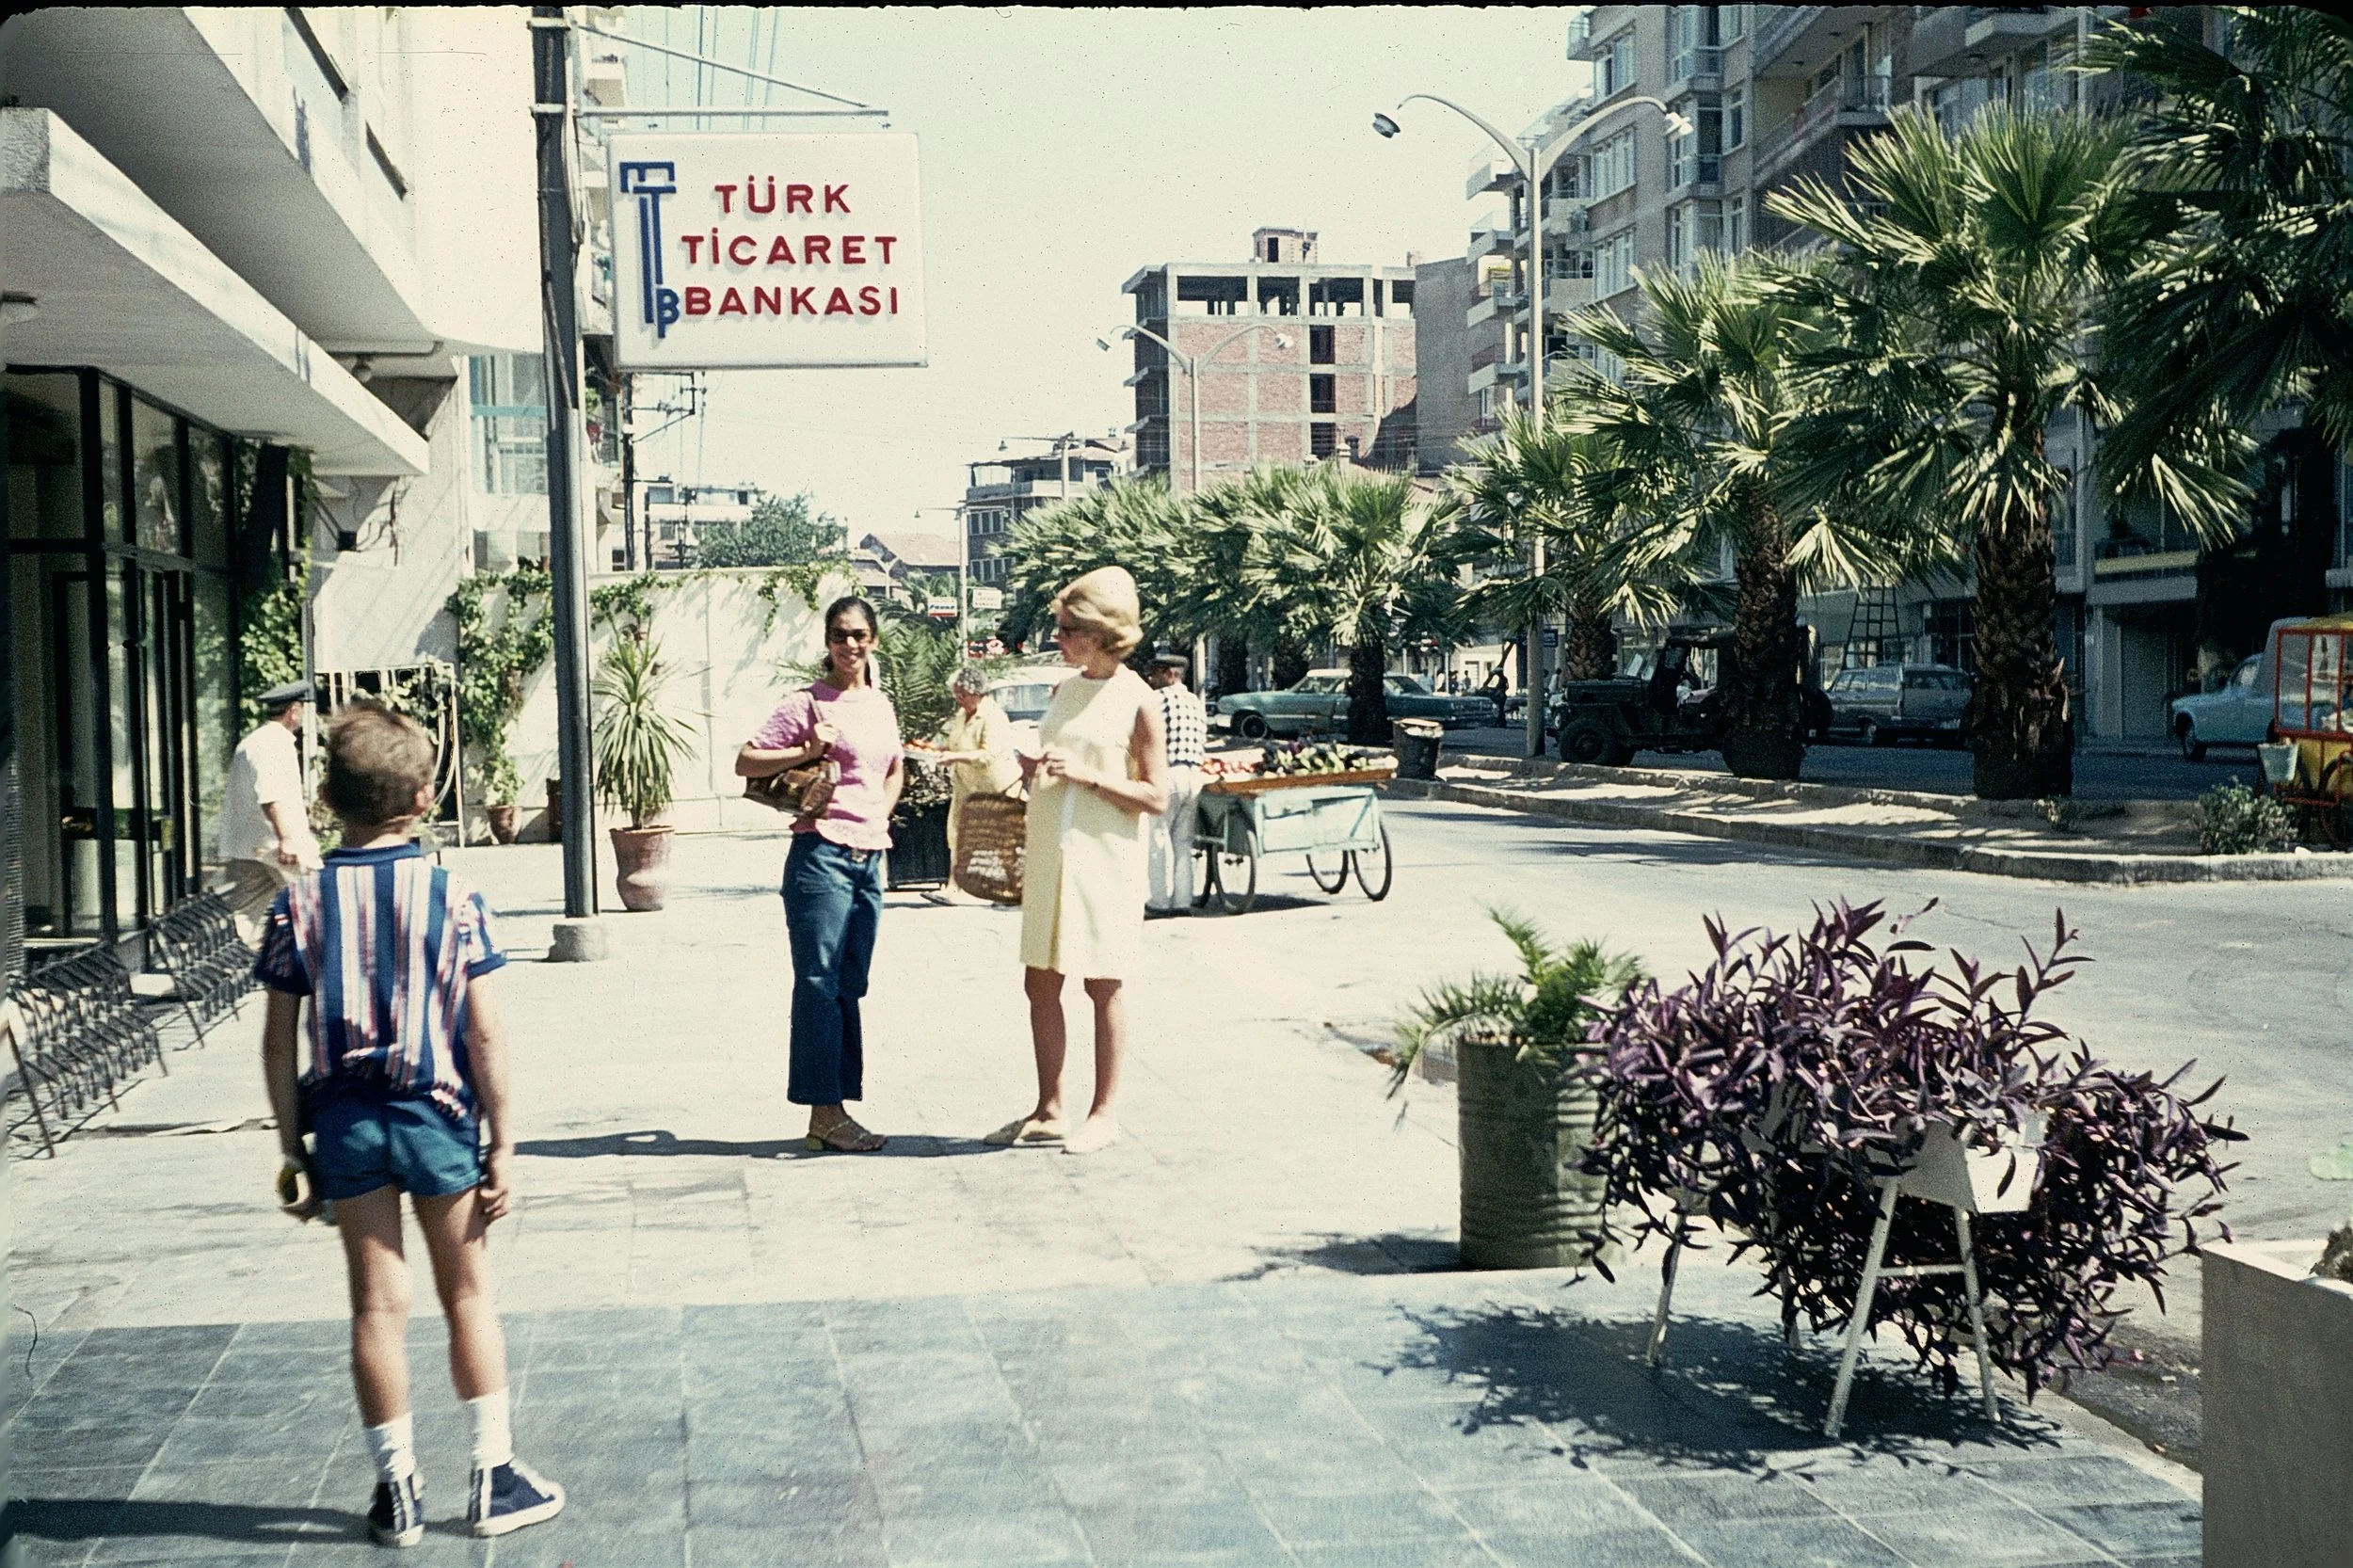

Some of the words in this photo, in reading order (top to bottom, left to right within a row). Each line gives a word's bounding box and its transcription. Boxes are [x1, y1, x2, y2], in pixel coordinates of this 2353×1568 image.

[714, 175, 851, 214] TÜRK
[680, 227, 897, 265] TİCARET
[684, 286, 898, 315] BANKASI
